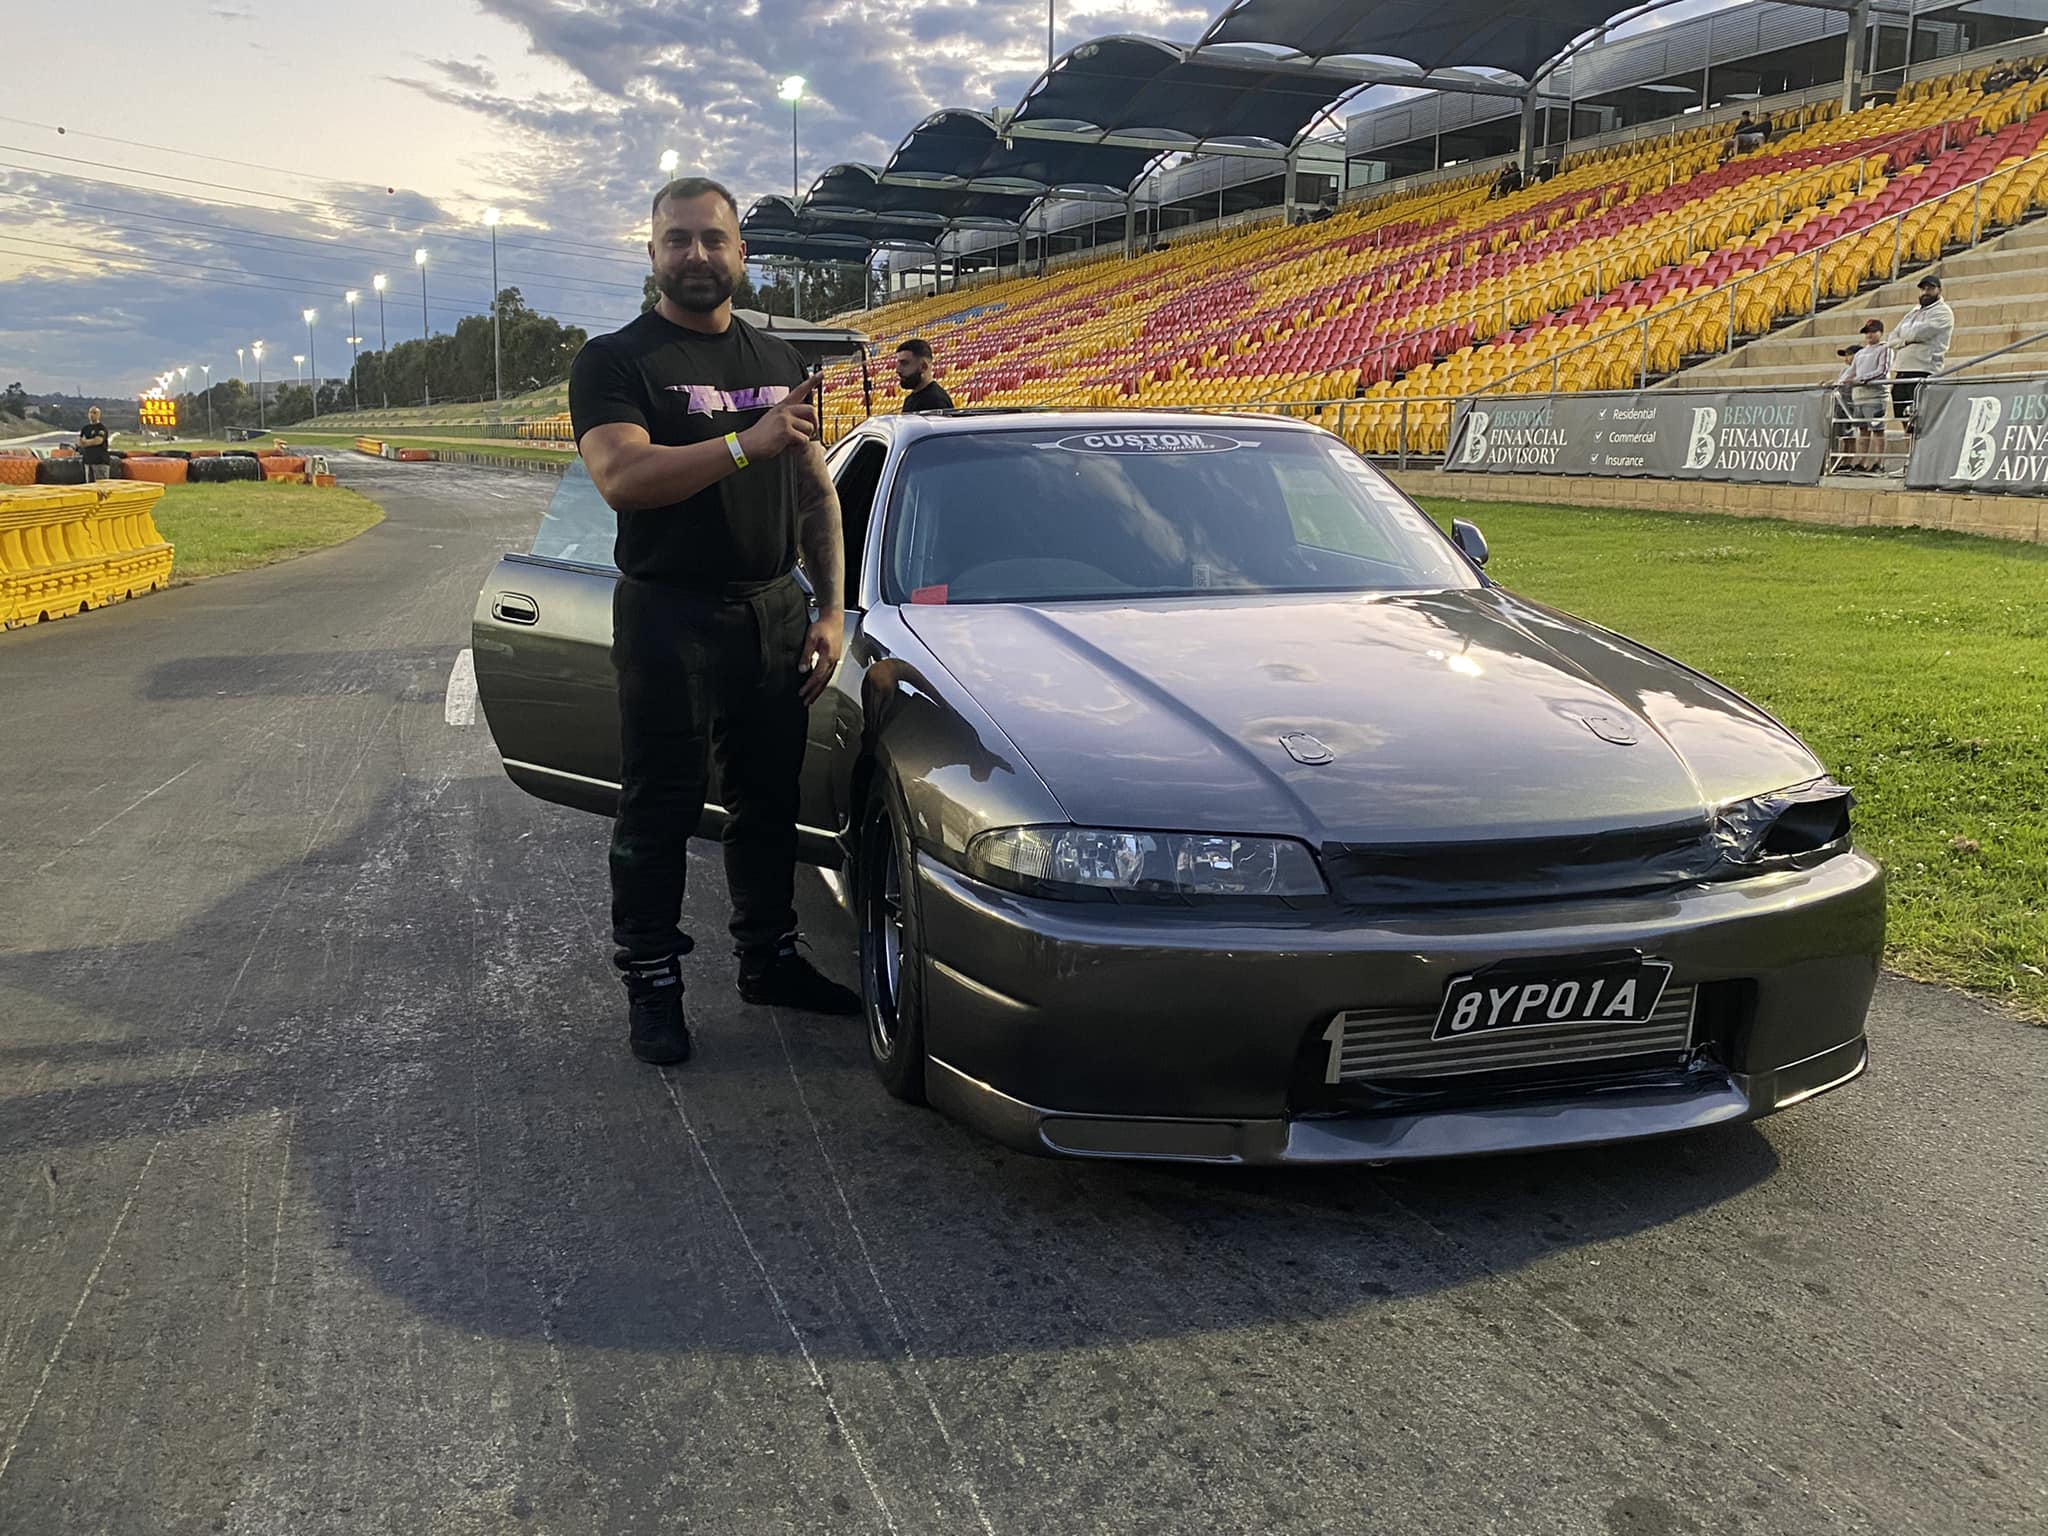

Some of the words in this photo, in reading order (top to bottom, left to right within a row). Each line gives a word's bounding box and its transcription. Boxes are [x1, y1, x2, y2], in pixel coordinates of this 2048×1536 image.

[1493, 409, 1553, 427] BESPOKE
[1612, 407, 1657, 420] Residential
[1723, 404, 1796, 425] BESPOKE
[1083, 433, 1202, 448] CUSTOM
[1490, 428, 1568, 446] FINANCIAL
[1608, 430, 1657, 444] Commercial
[1719, 427, 1811, 449] FINANCIAL
[1486, 446, 1560, 465] ADVISORY
[1604, 454, 1645, 467] Insurance
[1715, 450, 1802, 472] ADVISORY
